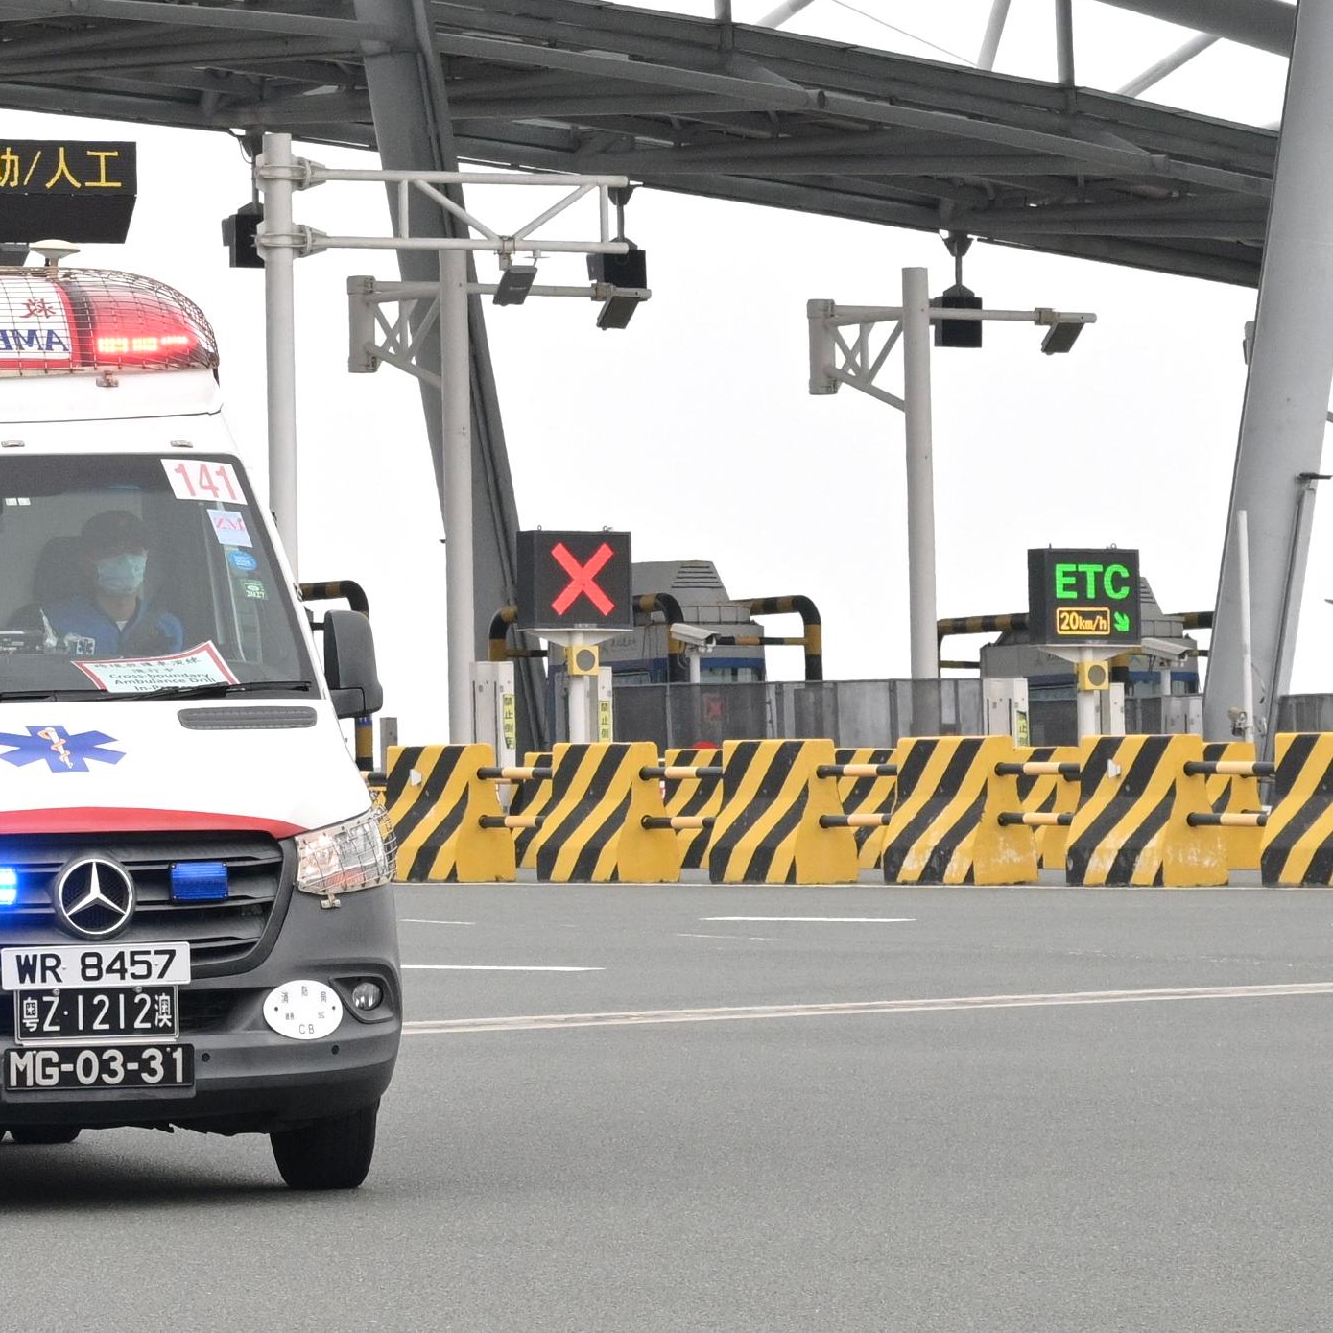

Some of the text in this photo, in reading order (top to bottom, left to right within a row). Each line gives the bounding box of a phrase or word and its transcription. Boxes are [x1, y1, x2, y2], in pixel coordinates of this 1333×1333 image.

[174, 463, 237, 501] 141
[1055, 563, 1131, 600] ETC
[1060, 611, 1108, 631] 20km/h
[113, 677, 188, 685] Ambulance
[15, 949, 177, 985] WR 8457
[9, 1047, 183, 1087] MG-03-31
